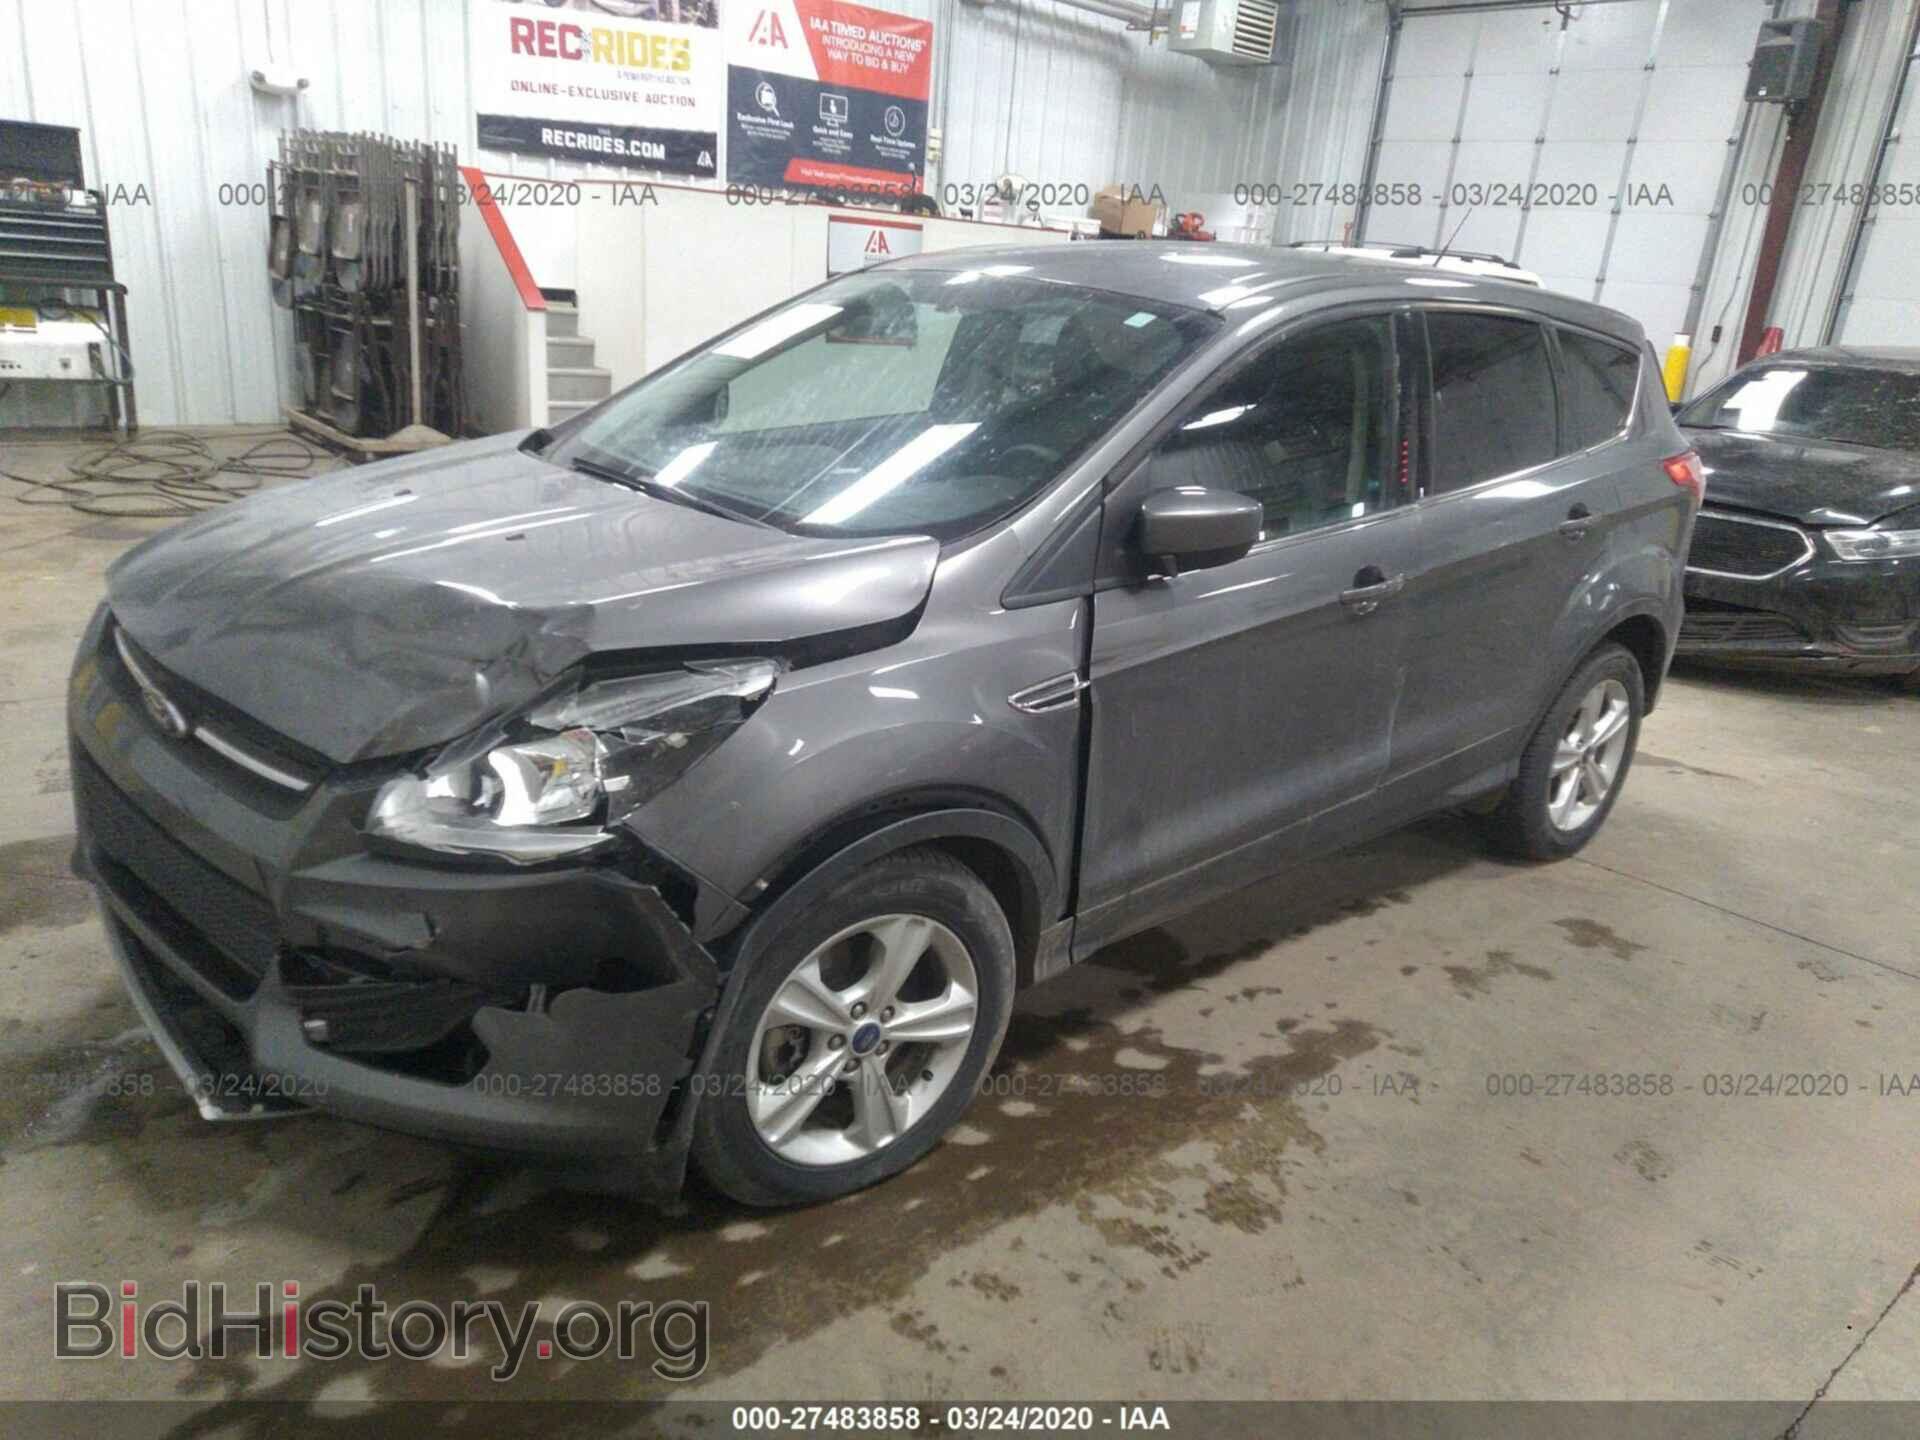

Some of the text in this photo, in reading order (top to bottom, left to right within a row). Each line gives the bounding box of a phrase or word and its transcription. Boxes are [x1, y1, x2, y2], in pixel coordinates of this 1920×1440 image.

[809, 16, 829, 33] IAA
[830, 20, 866, 38] TIMED
[510, 17, 691, 72] REC RIDES
[822, 36, 916, 63] INTRODUCING A NEW
[827, 48, 909, 74] WAY TO BID & BUY
[510, 79, 696, 107] ONLINE-EXCLUSIVE AUCTION
[541, 127, 666, 161] RECRIDES.COM
